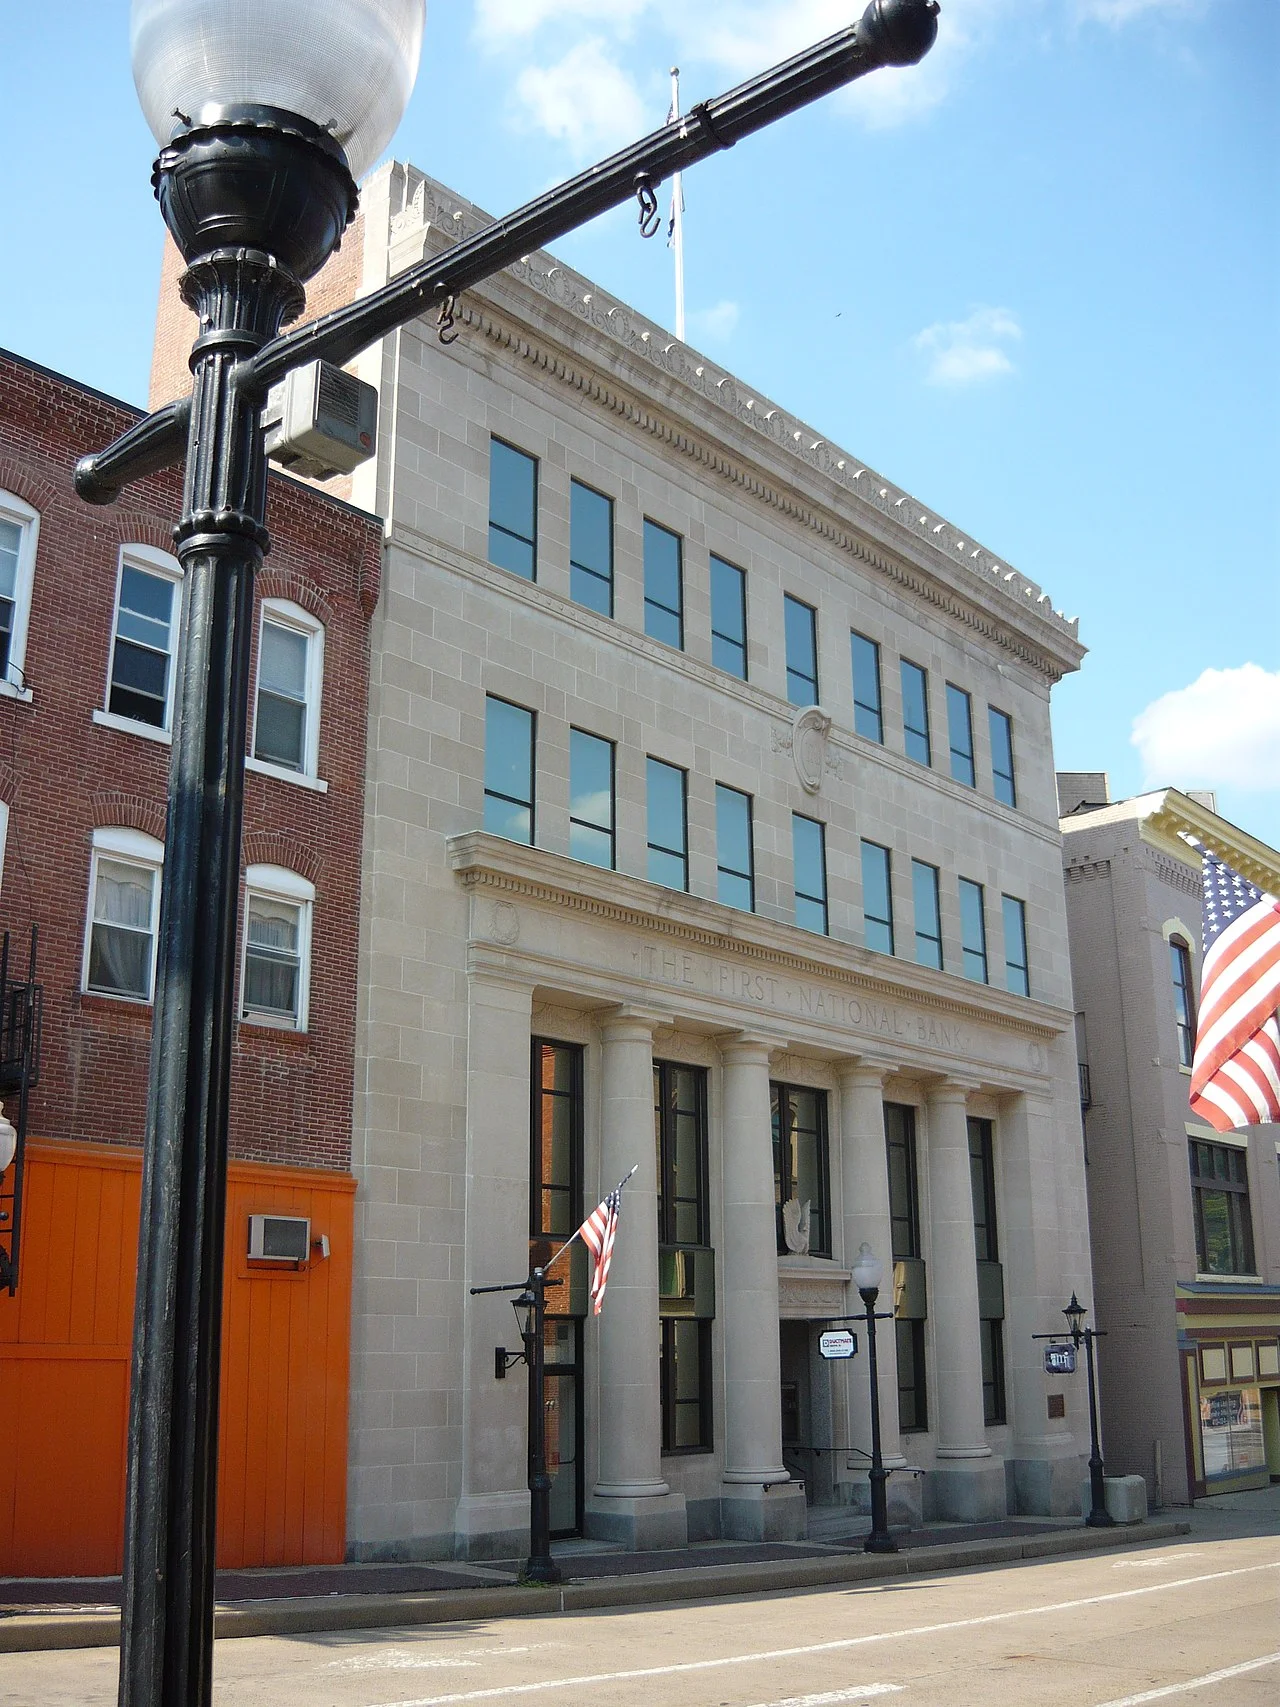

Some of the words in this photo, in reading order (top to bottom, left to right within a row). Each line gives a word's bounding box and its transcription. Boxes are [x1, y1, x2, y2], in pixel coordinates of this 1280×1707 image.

[644, 946, 693, 984] THE
[719, 966, 778, 1004] FIRST
[799, 986, 902, 1034] NATIONAL
[918, 1016, 963, 1050] BANK
